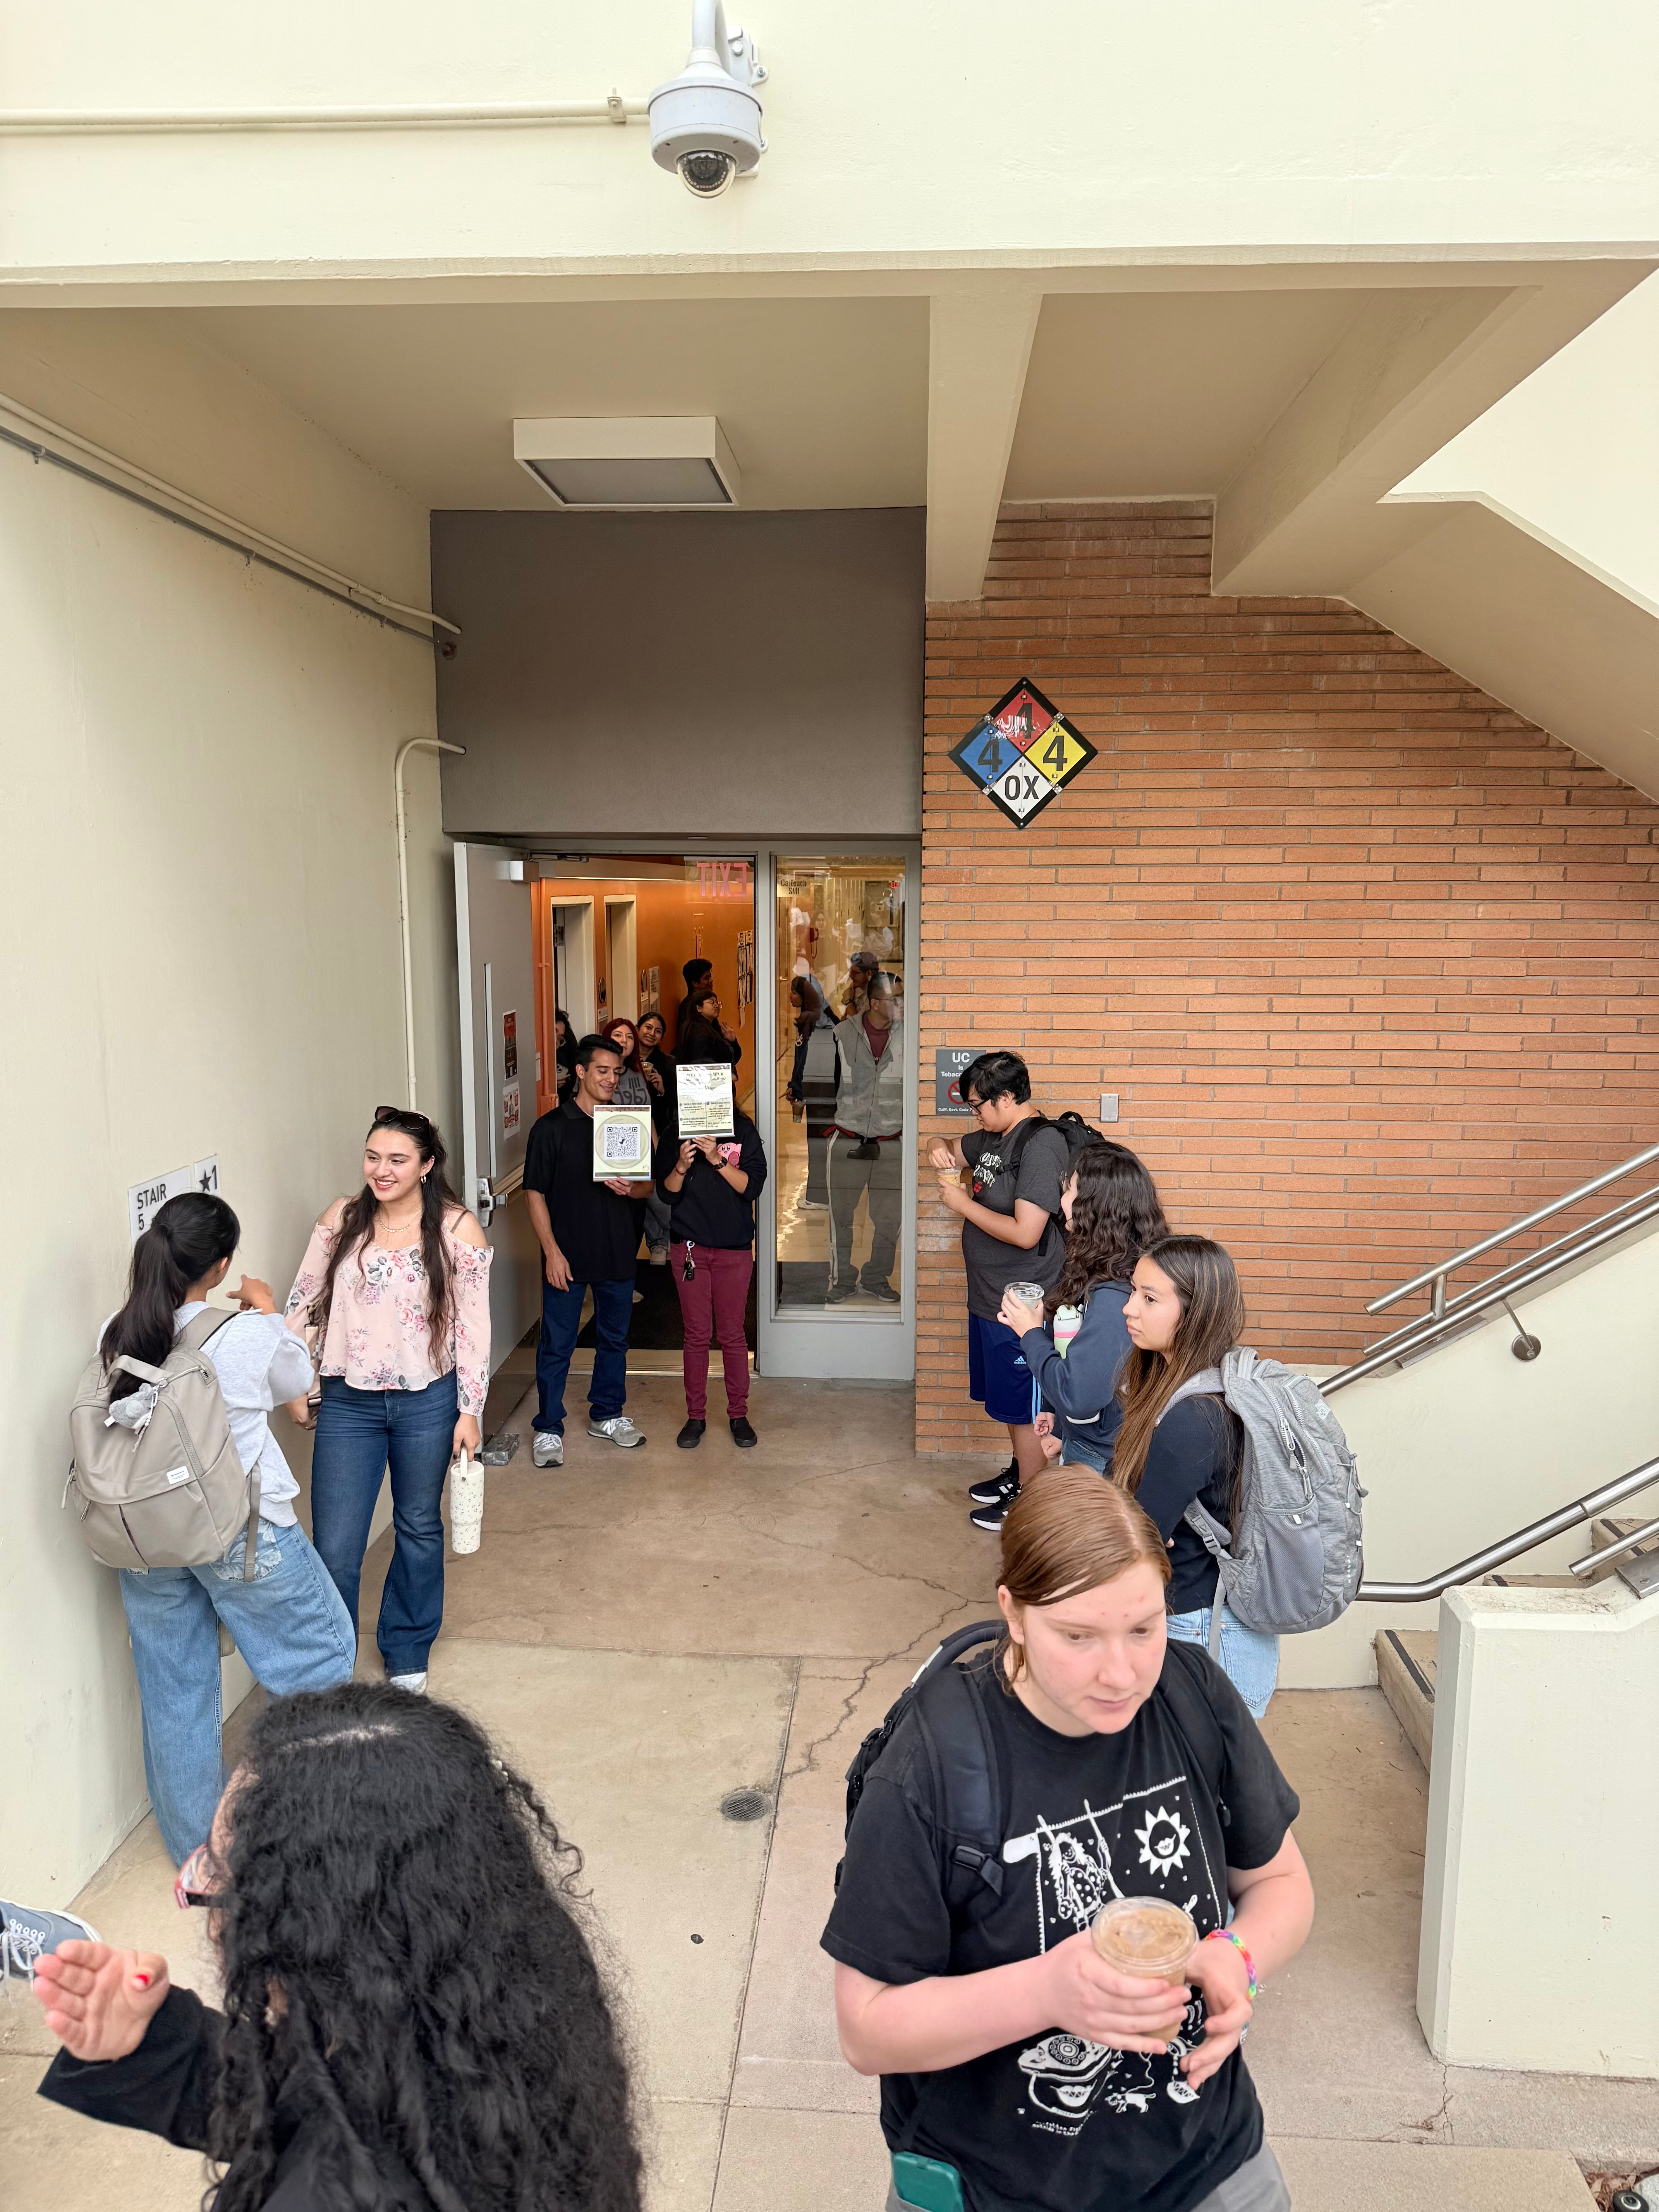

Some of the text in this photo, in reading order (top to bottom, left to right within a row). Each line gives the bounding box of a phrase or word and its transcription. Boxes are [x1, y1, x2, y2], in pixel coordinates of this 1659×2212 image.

[1016, 703, 1036, 739] 4
[978, 738, 1002, 773] 4
[1043, 735, 1068, 771] 4
[1005, 775, 1040, 800] OX
[952, 1052, 970, 1063] UC
[137, 1183, 167, 1210] STAIR
[138, 1213, 144, 1231] 5
